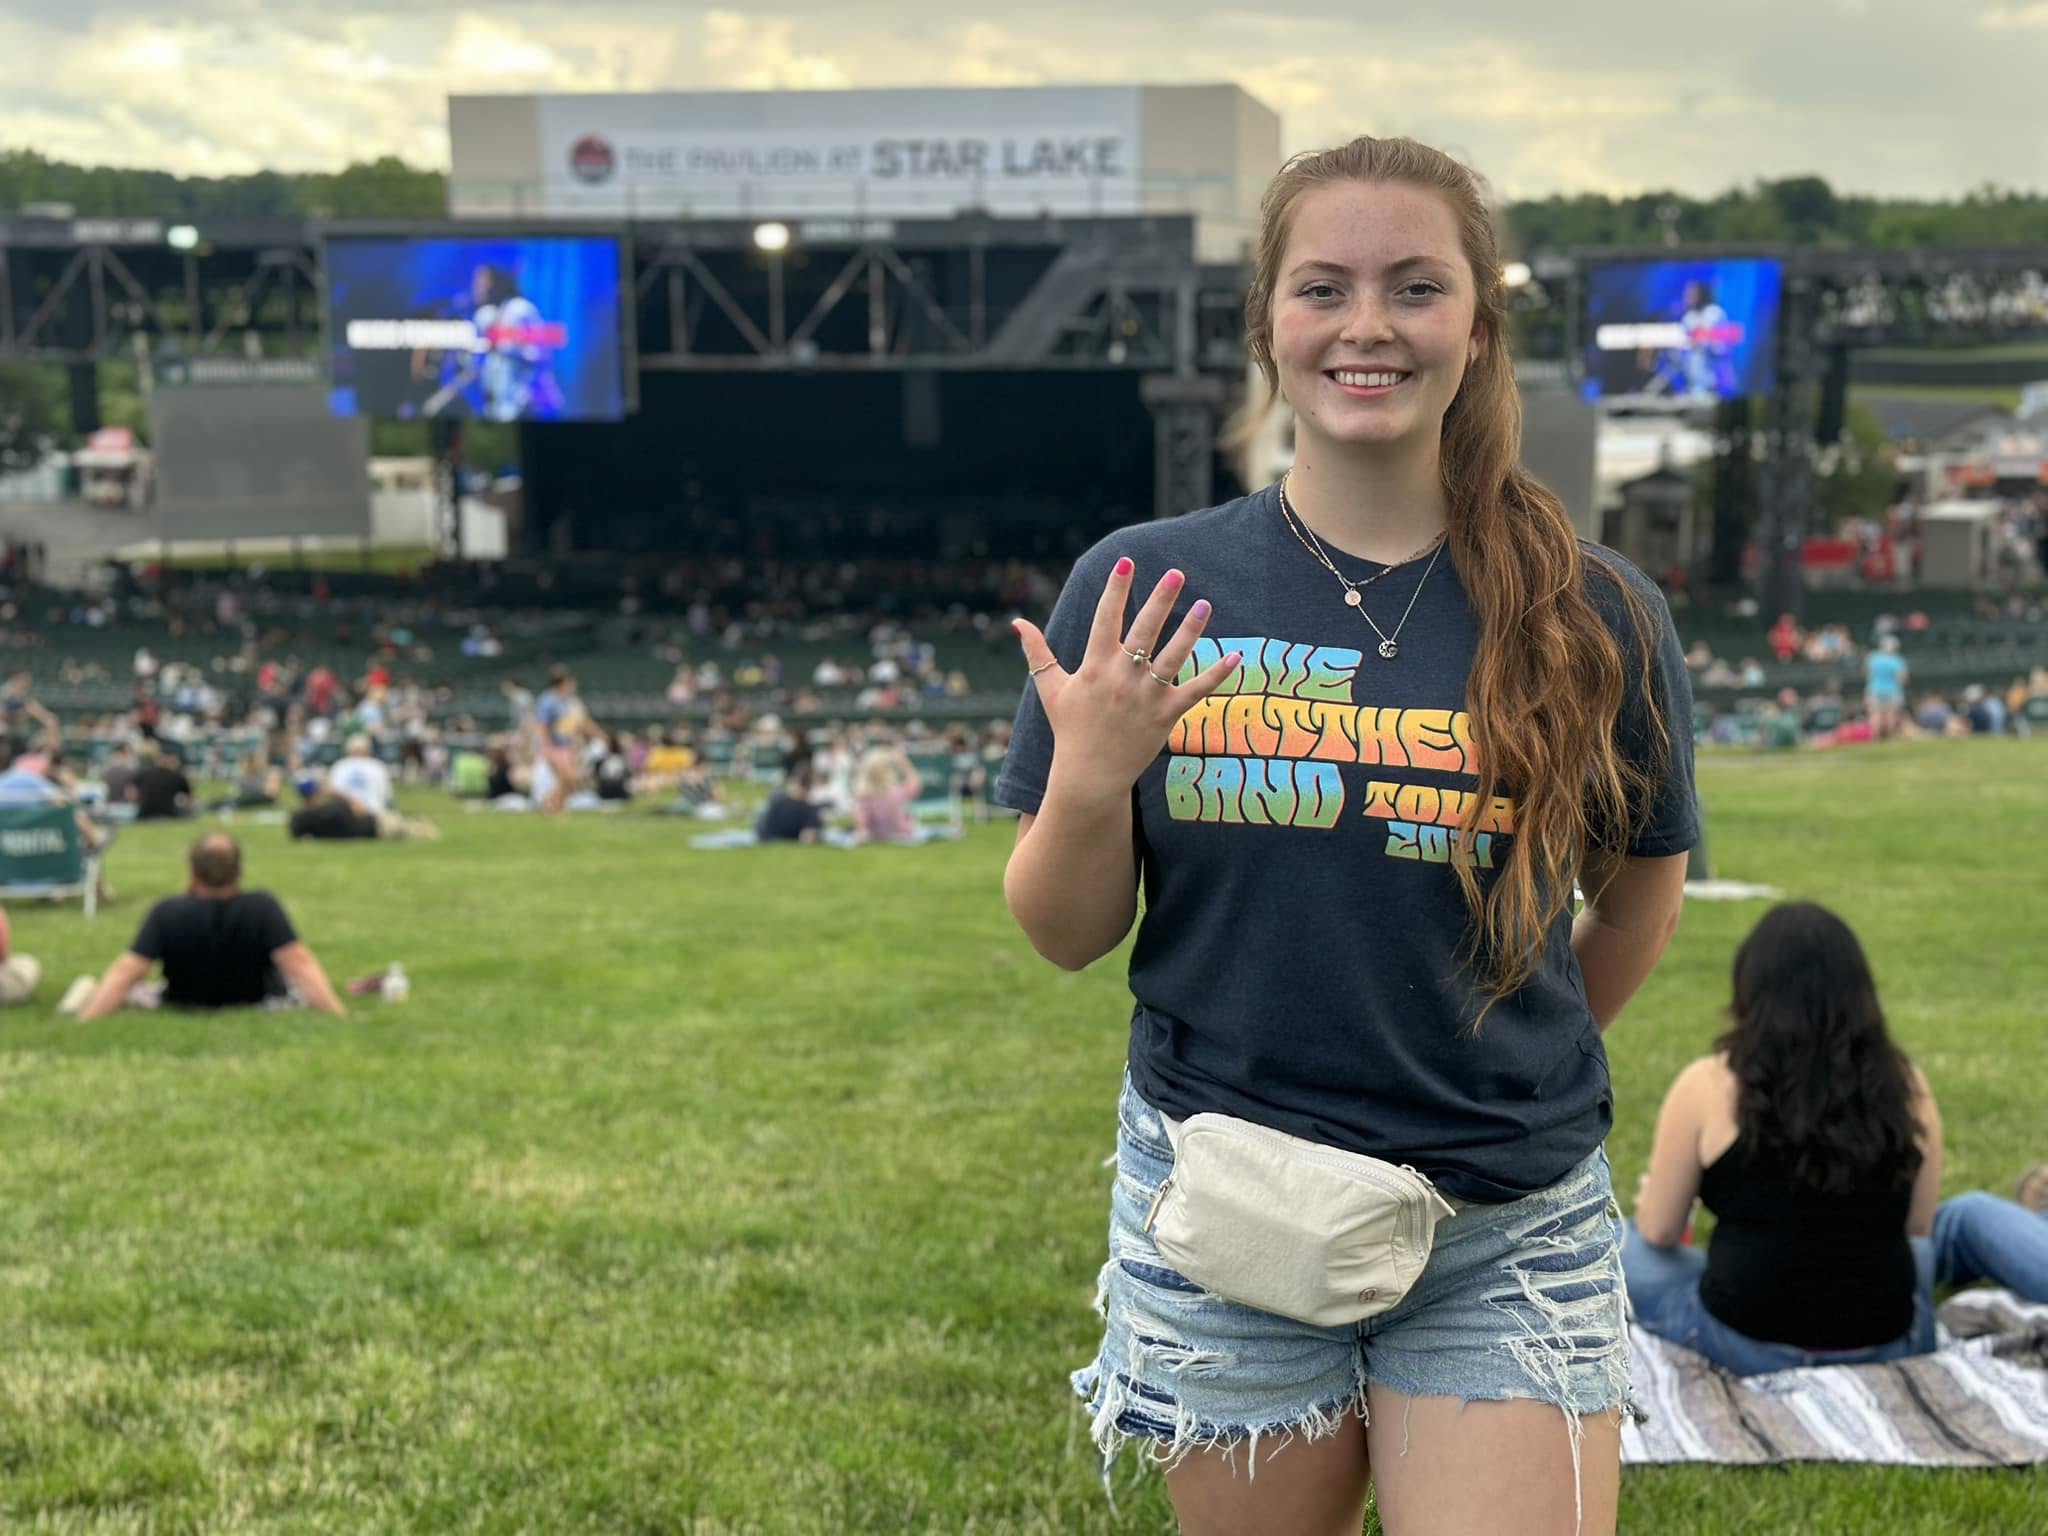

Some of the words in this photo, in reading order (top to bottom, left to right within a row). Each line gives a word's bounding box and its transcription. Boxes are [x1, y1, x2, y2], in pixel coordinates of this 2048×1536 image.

[623, 146, 678, 176] THE
[688, 146, 820, 176] PAVILION
[872, 137, 988, 178] STAR
[1002, 136, 1124, 177] LAKE
[1168, 695, 1484, 776] MATTHE
[1165, 755, 1346, 829] BAND
